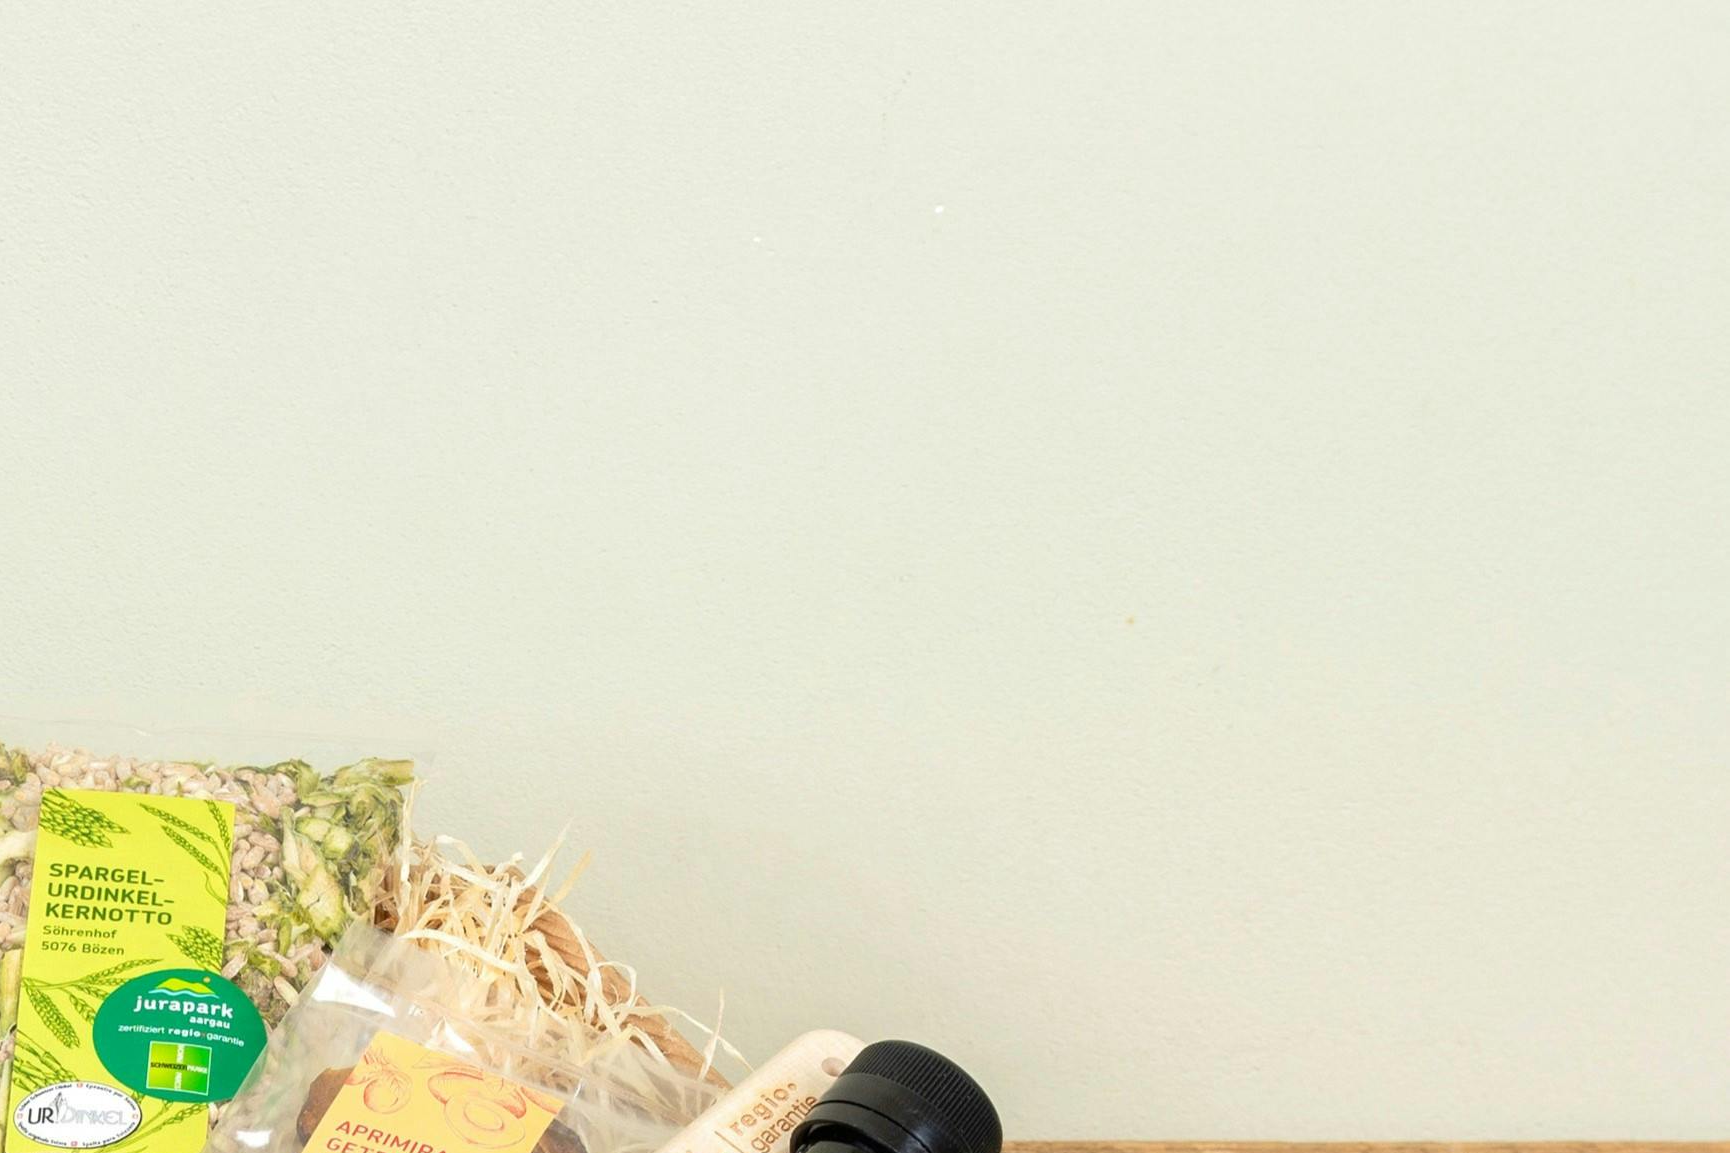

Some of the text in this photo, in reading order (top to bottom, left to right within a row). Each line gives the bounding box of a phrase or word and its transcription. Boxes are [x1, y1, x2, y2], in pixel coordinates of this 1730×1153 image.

[49, 863, 164, 886] SPARGEL-
[48, 882, 174, 907] URDINKEL-
[45, 902, 172, 925] KERNOTTO
[42, 925, 117, 939] Söhrenhof
[41, 941, 124, 956] 5076 Bözen
[133, 995, 233, 1019] jurapark
[118, 1024, 165, 1034] zertifiziert
[189, 1015, 231, 1029] aargau
